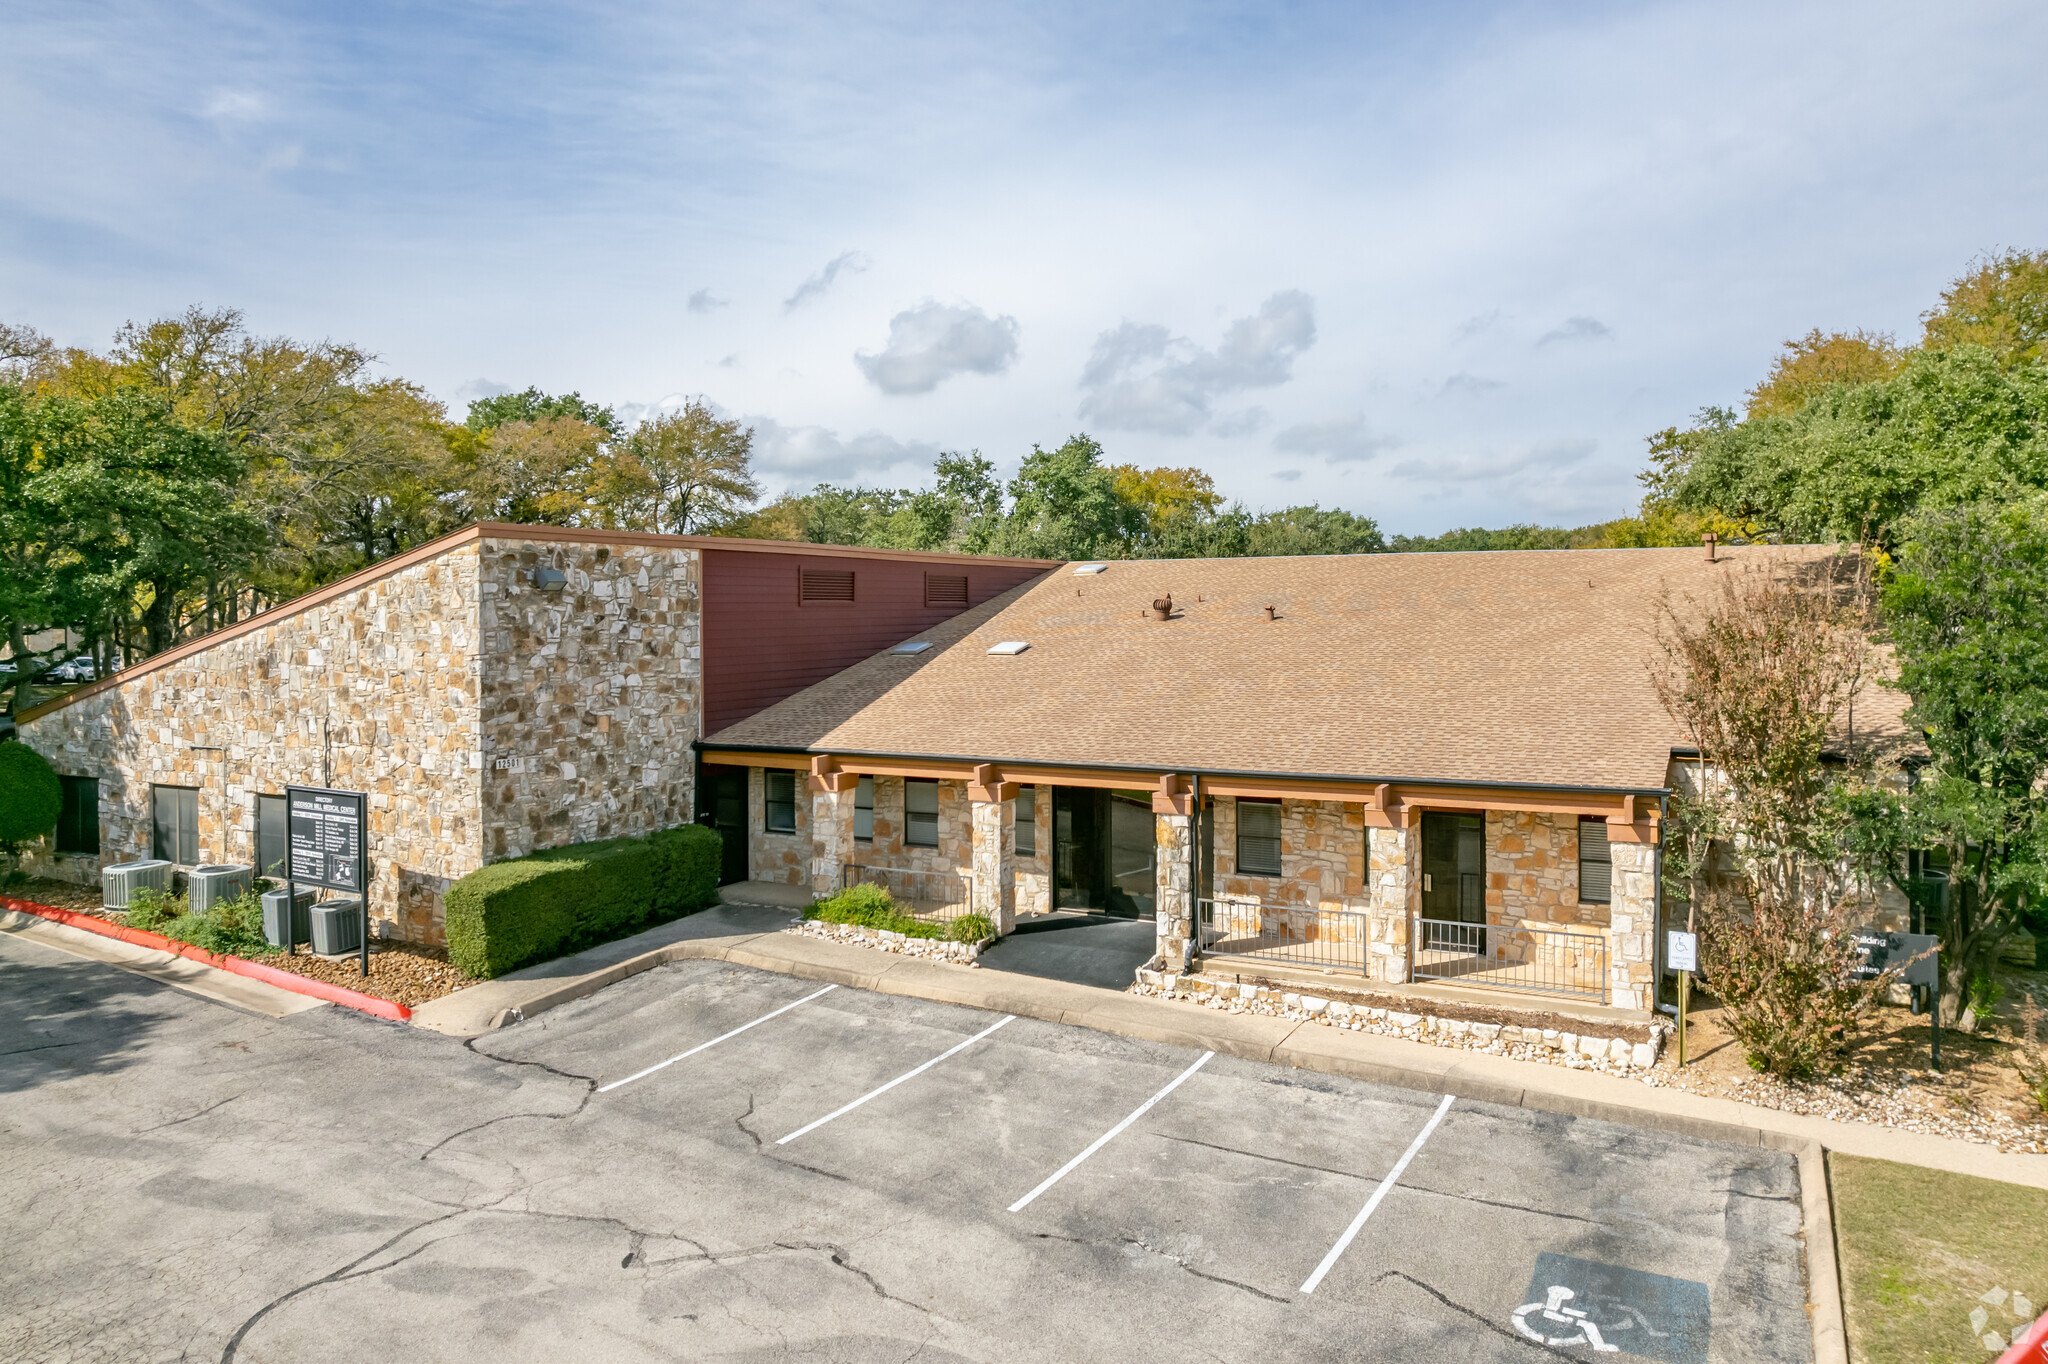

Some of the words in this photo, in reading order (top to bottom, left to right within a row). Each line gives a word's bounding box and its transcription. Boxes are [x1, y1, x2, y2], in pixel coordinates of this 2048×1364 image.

[498, 758, 519, 768] 12501
[293, 800, 314, 809] ANDERSON
[322, 804, 339, 812] MEDICAL
[339, 806, 356, 815] CENTER
[1851, 965, 1880, 974] uites
